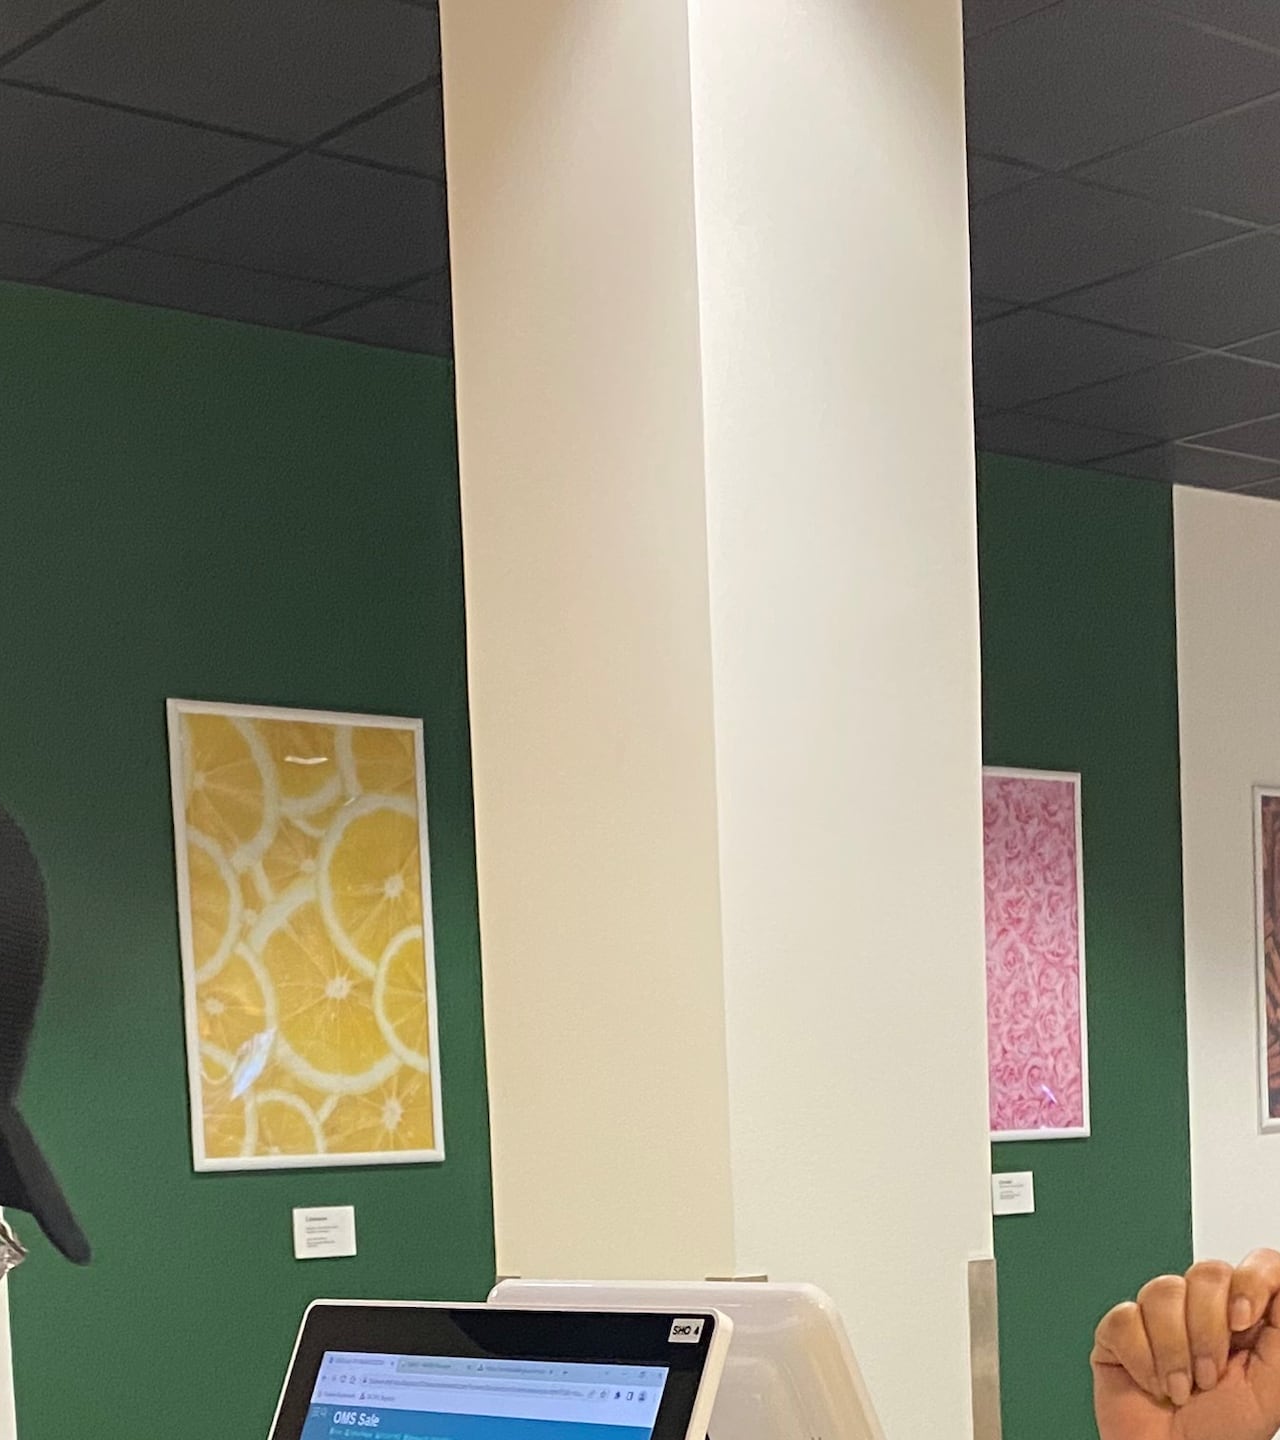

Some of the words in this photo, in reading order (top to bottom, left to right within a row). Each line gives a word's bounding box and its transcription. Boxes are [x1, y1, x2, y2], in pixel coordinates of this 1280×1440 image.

[672, 1325, 691, 1337] SHO
[693, 1326, 700, 1336] 4
[333, 1411, 357, 1426] OMS
[358, 1412, 380, 1428] Sale
